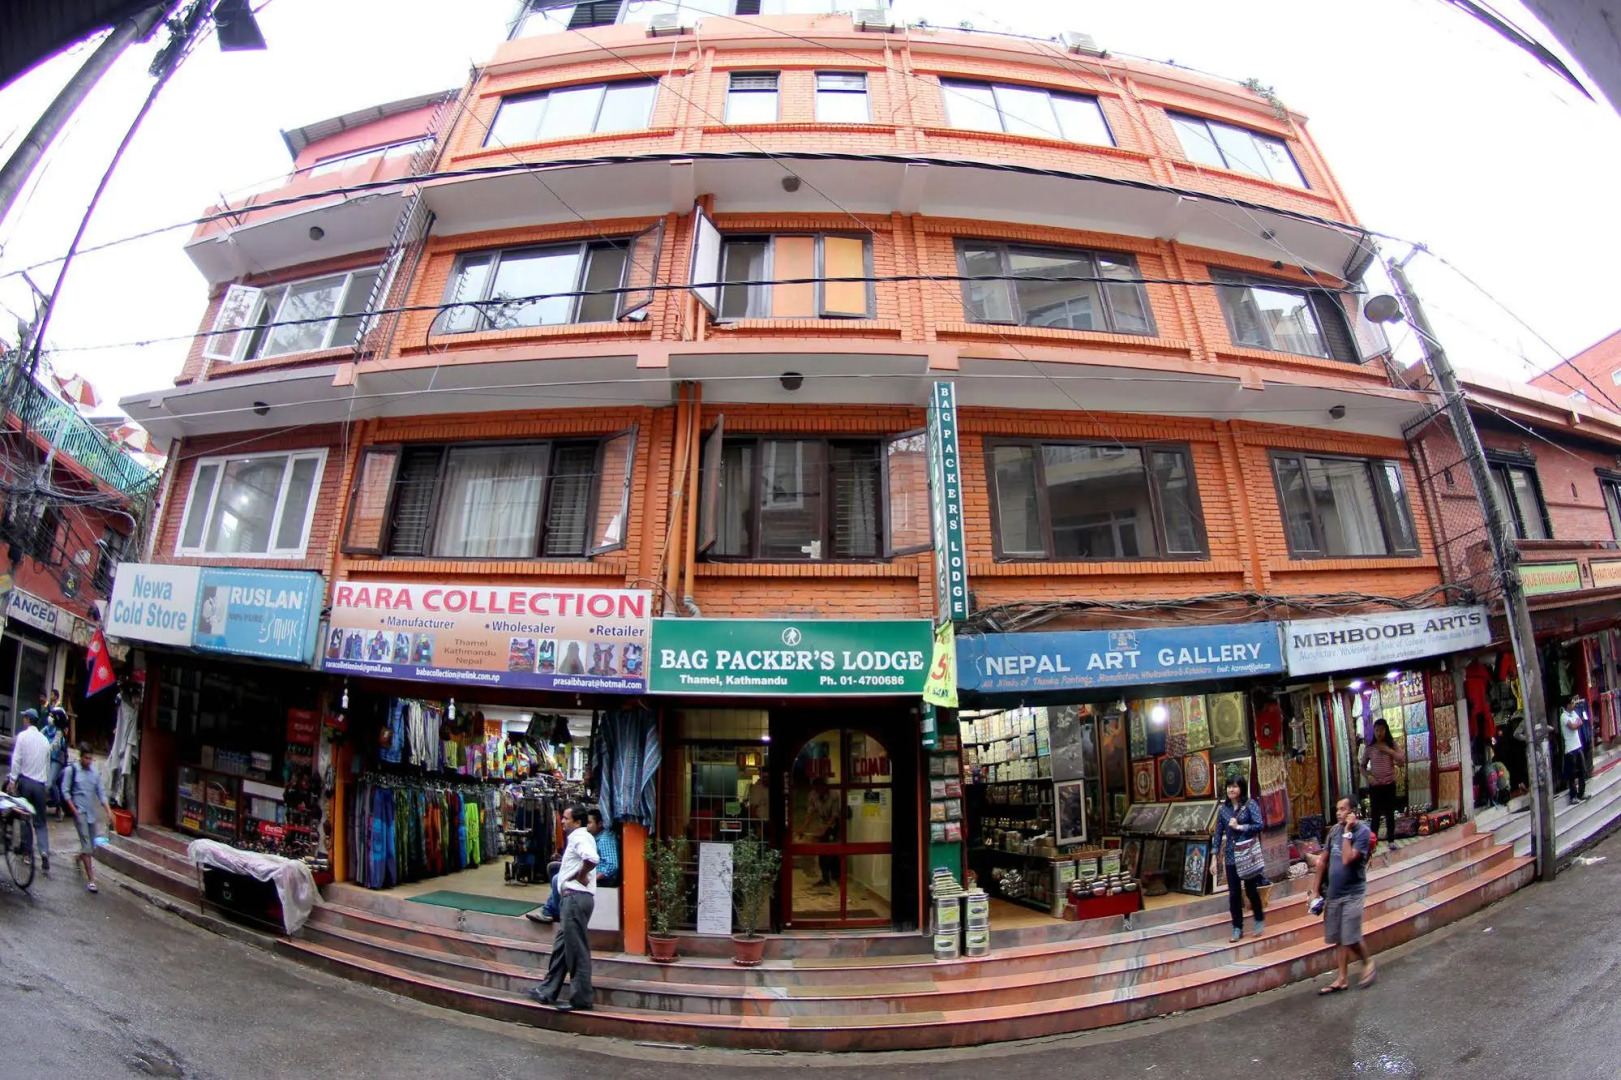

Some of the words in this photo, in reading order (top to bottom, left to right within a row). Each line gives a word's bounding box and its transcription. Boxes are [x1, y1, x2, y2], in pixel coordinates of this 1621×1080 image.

[941, 388, 951, 421] BAG
[943, 430, 958, 530] PACKER'S
[132, 574, 173, 600] Newa
[951, 541, 963, 612] LODGE
[230, 587, 303, 610] RUSLAN
[336, 586, 413, 610] RARA
[422, 589, 645, 618] COLLECTION
[114, 600, 144, 626] Cold
[146, 602, 187, 631] Store
[387, 616, 455, 629] Manufacturer
[492, 621, 555, 634] Wholesaler
[597, 625, 645, 637] Retailer
[1293, 622, 1415, 649] MEHBOOB
[1423, 612, 1481, 633] ARTS
[444, 647, 496, 657] Kathmandu
[455, 638, 488, 647] Thamel
[456, 657, 483, 666] Nepal
[660, 649, 709, 669] BAG
[715, 650, 835, 670] PACKER'S
[842, 650, 924, 670] LODGE
[985, 654, 1071, 676] NEPAL
[1086, 650, 1141, 670] ART
[1158, 642, 1262, 667] GALLERY
[679, 674, 722, 686] Thamel,
[725, 675, 788, 685] Kathmandu
[820, 675, 837, 685] Ph.
